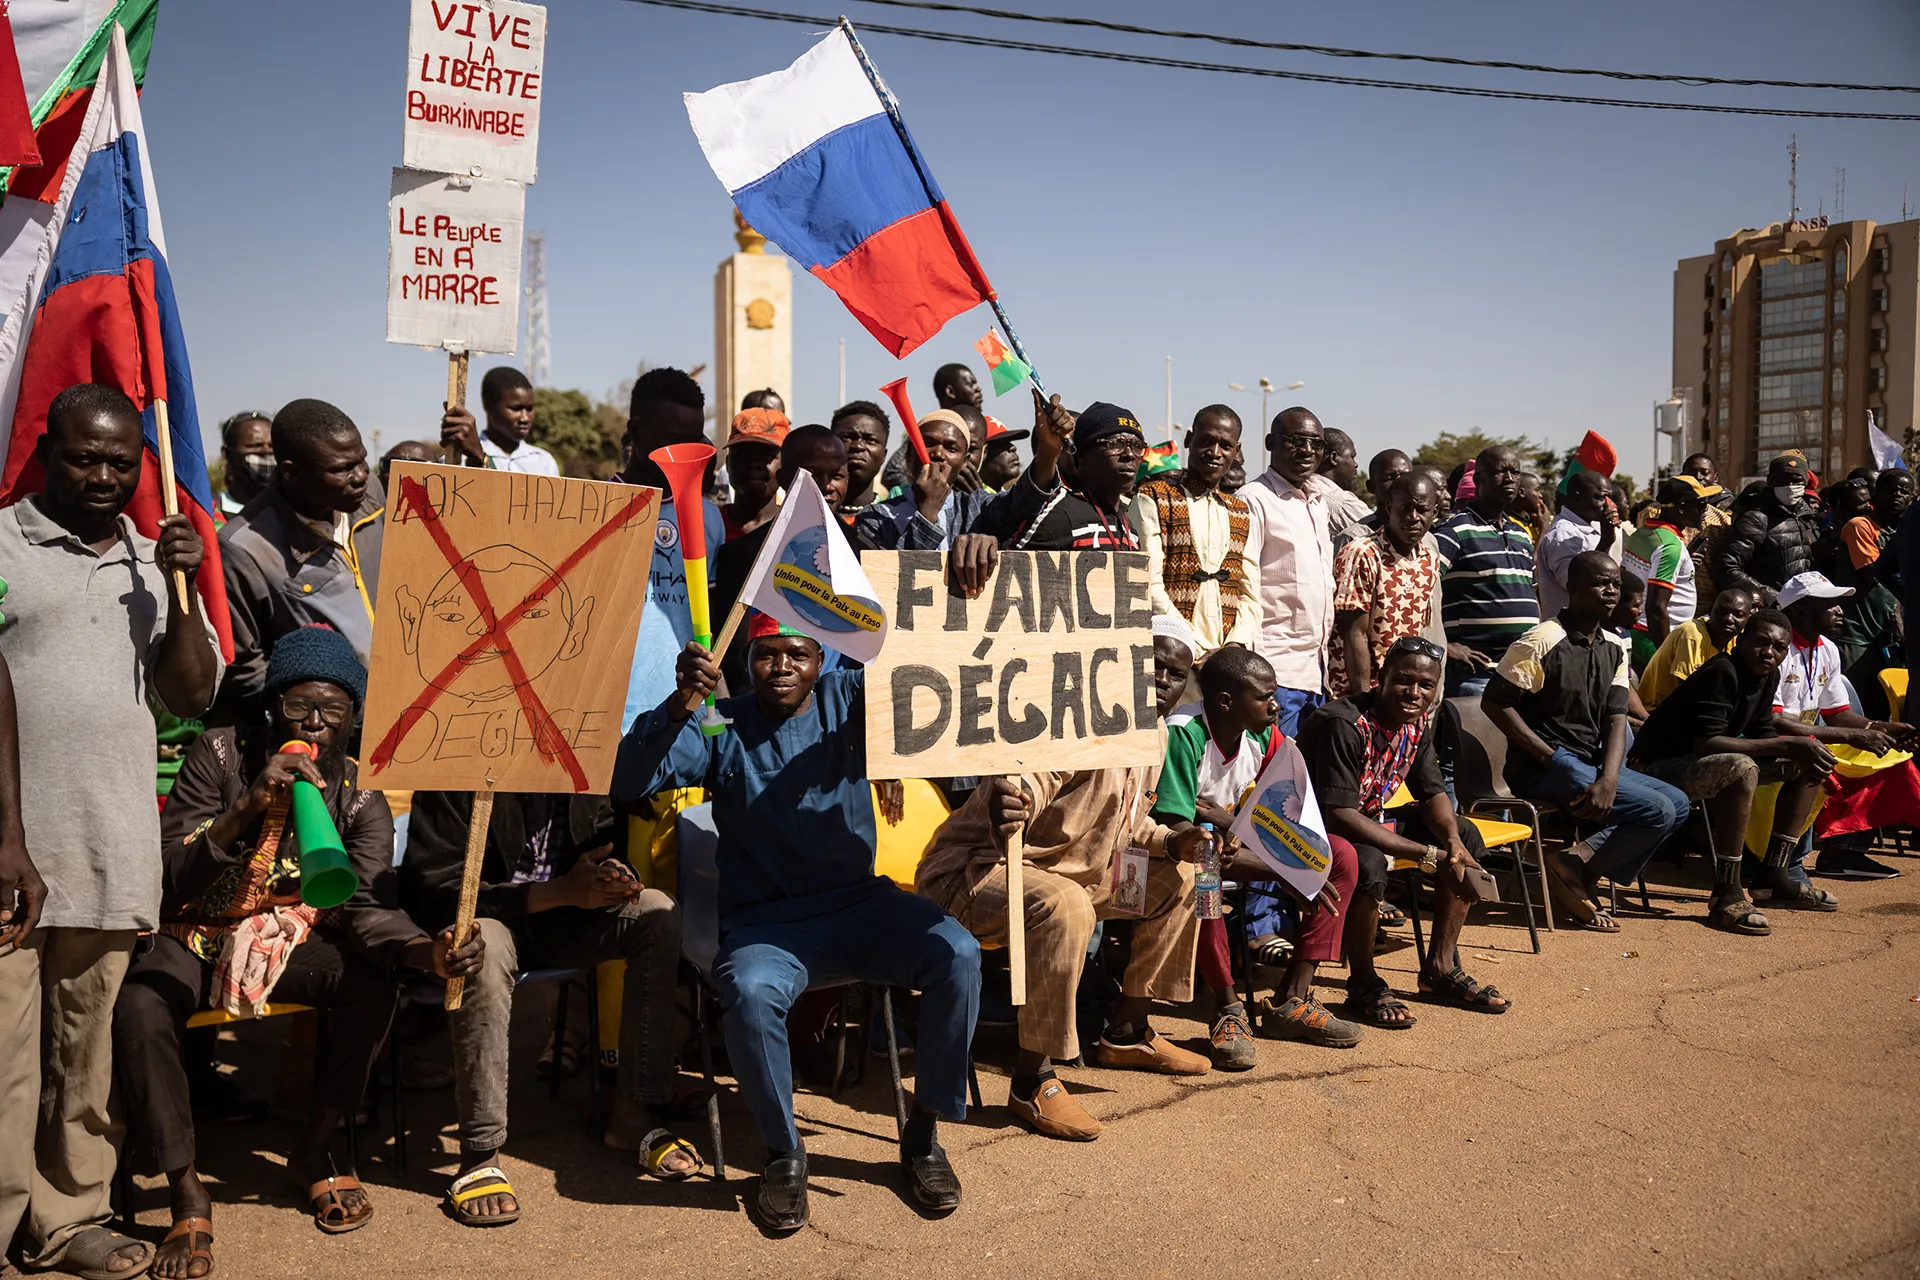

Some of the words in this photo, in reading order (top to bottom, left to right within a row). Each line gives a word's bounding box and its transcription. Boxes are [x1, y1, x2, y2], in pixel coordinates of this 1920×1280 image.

[431, 0, 530, 50] VIVE
[467, 41, 494, 67] LA
[421, 53, 540, 99] LIBERTE
[400, 207, 426, 236] LE
[415, 246, 443, 268] EN
[454, 246, 473, 270] A
[402, 273, 499, 306] MARRE
[774, 568, 800, 584] Union
[799, 579, 821, 595] pour
[820, 590, 830, 601] la
[830, 595, 850, 613] Paix
[849, 609, 861, 620] au
[861, 613, 881, 629] Faso
[1252, 808, 1270, 823] Union
[1269, 820, 1285, 834] pour
[1283, 831, 1290, 841] la
[1289, 837, 1304, 853] Paix
[1302, 850, 1312, 860] au
[1310, 856, 1326, 870] Faso
